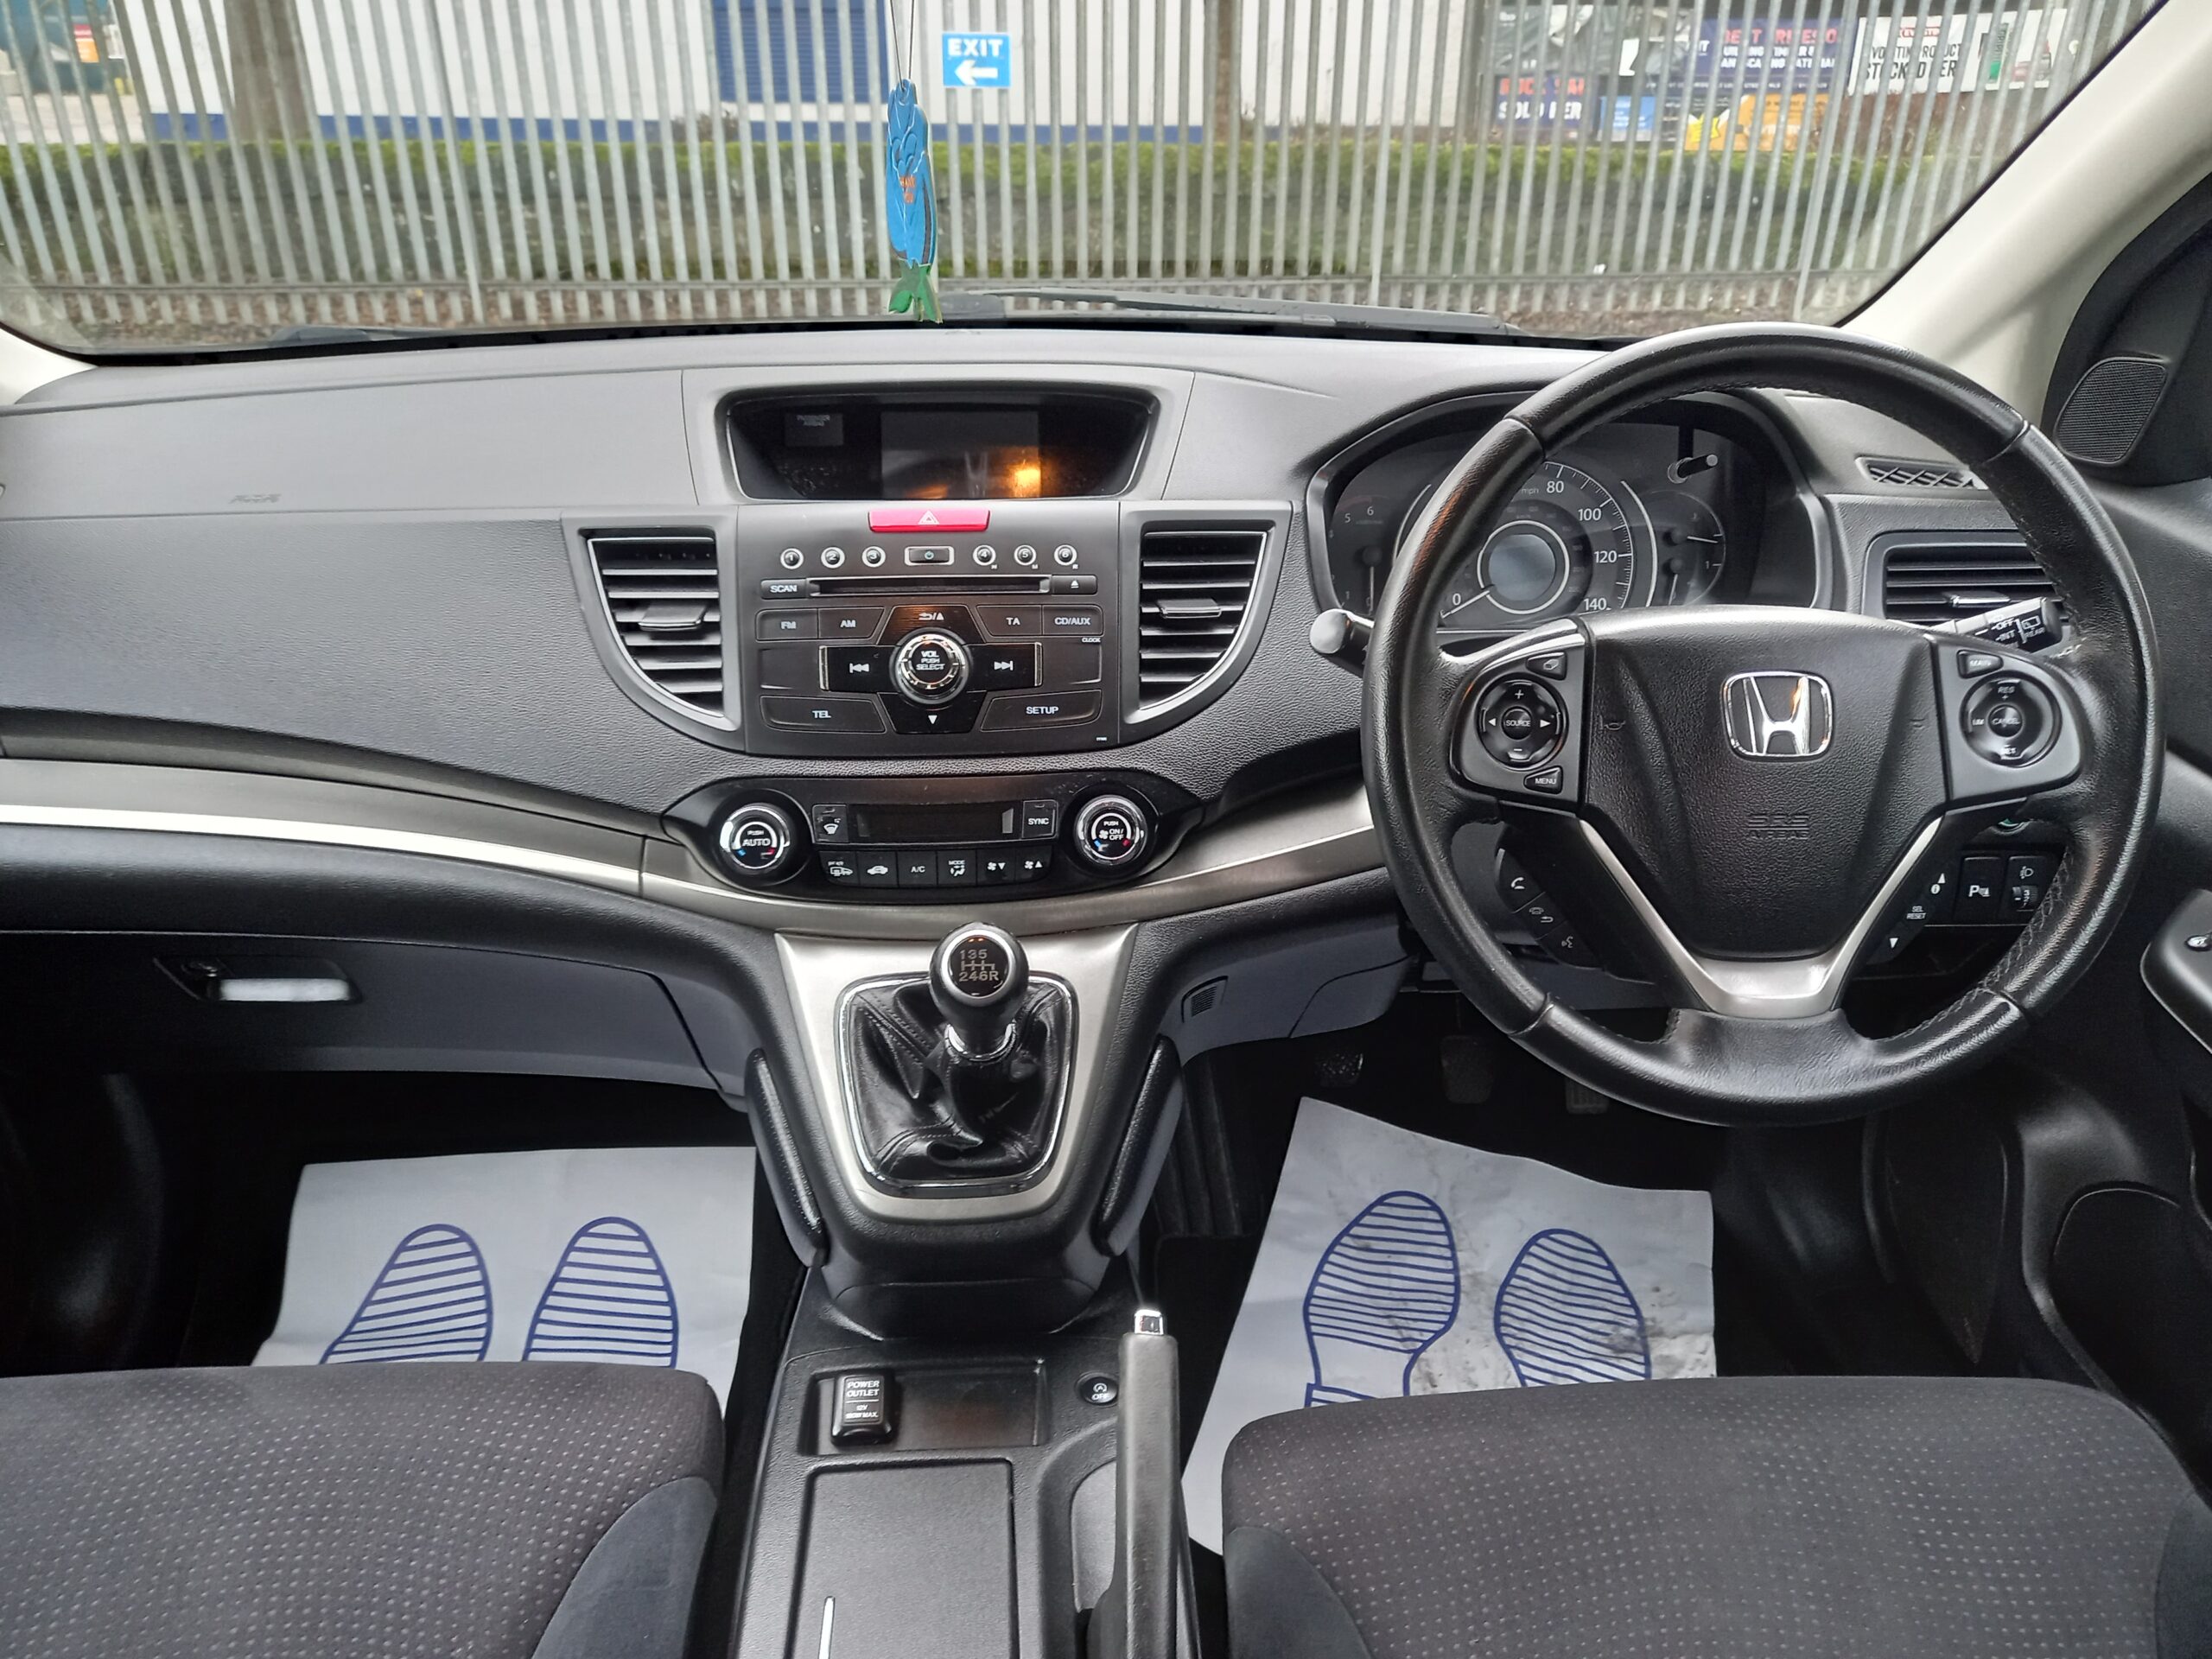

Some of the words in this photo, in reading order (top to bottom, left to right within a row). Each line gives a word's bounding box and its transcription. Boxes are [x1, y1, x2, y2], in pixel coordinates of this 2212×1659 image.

[947, 38, 1003, 57] EXIT
[1546, 480, 1565, 493] 80
[1367, 506, 1374, 516] 6
[1578, 508, 1602, 521] 100
[1344, 512, 1351, 524] 5
[1594, 550, 1618, 563] 120
[1452, 593, 1461, 606] 0
[1584, 597, 1607, 611] 140
[1006, 617, 1020, 626] TA
[1054, 617, 1090, 626] CD/AUX
[1026, 706, 1059, 715] SETUP
[847, 1380, 880, 1389] POWER
[847, 1389, 880, 1397] OUTLET
